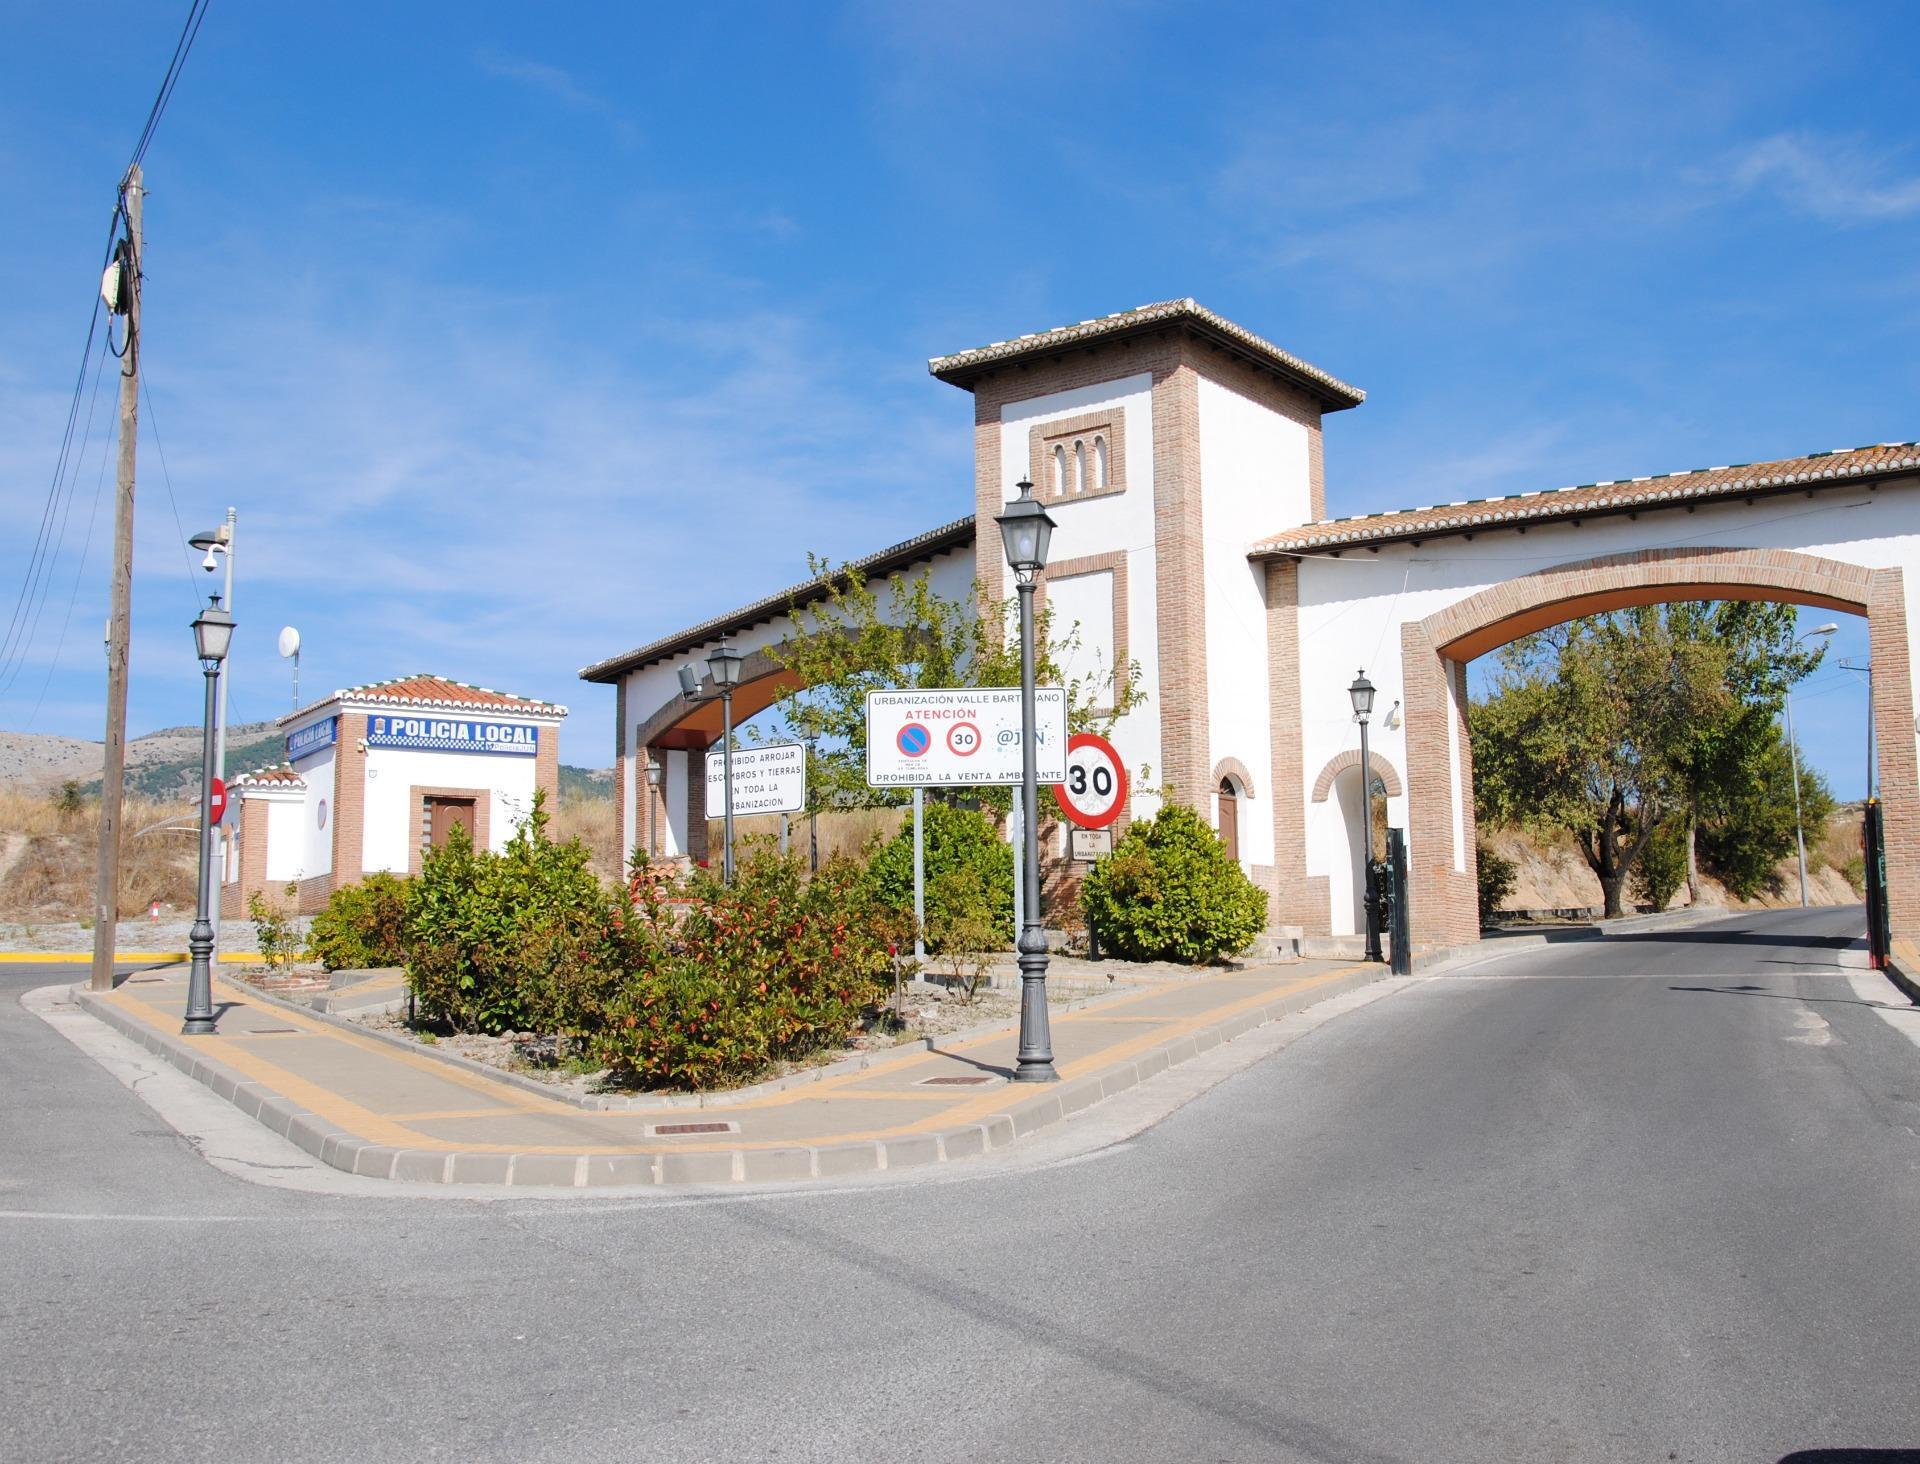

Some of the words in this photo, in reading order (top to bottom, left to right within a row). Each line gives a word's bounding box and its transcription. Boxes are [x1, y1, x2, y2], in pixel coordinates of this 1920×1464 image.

[874, 695, 953, 706] URBANIZACIÓN
[957, 694, 990, 704] VALLE
[993, 693, 1060, 703] BARTANO
[905, 708, 976, 720] ATENCIÓN
[390, 718, 470, 740] POLICIA
[474, 724, 535, 744] LOCAL
[997, 729, 1045, 745] @JN
[954, 734, 973, 745] 30
[759, 751, 795, 762] ARROJAR
[708, 770, 756, 783] ESCMBROS
[760, 769, 765, 777] Y
[768, 765, 801, 776] TIERRAS
[876, 773, 932, 782] PROHIBIDA
[938, 773, 952, 781] LA
[958, 772, 992, 781] VENTA
[998, 771, 1062, 780] AMBANTE
[1069, 764, 1112, 796] 30
[744, 785, 765, 794] TODA
[768, 783, 778, 792] LA
[730, 798, 783, 810] RBANIZACION
